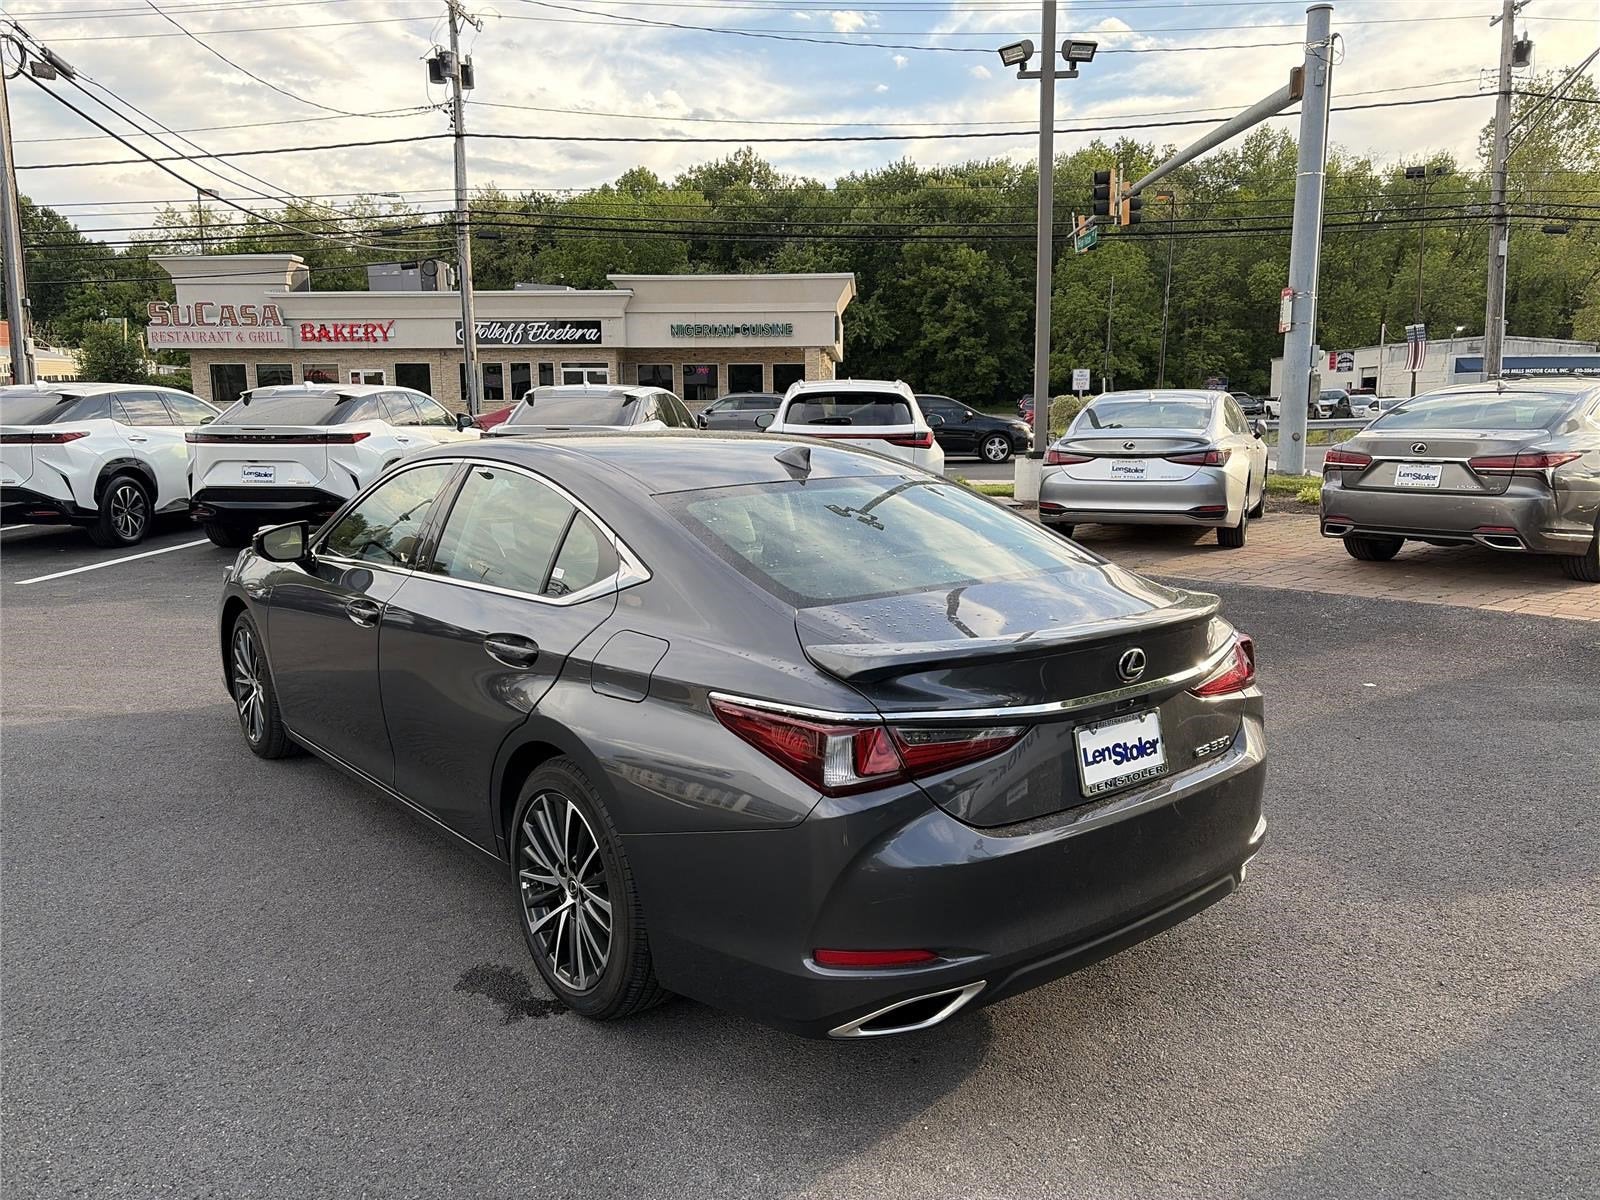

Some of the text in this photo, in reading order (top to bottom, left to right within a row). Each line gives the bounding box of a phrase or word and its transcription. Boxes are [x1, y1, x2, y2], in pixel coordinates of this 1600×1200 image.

[151, 331, 284, 343] RESTAURANT & GRILL
[300, 320, 394, 342] BAKERY
[527, 322, 600, 341] Etcetera
[670, 323, 793, 337] NIGERIAN CUISINE
[1089, 765, 1165, 793] LEN STOLER
